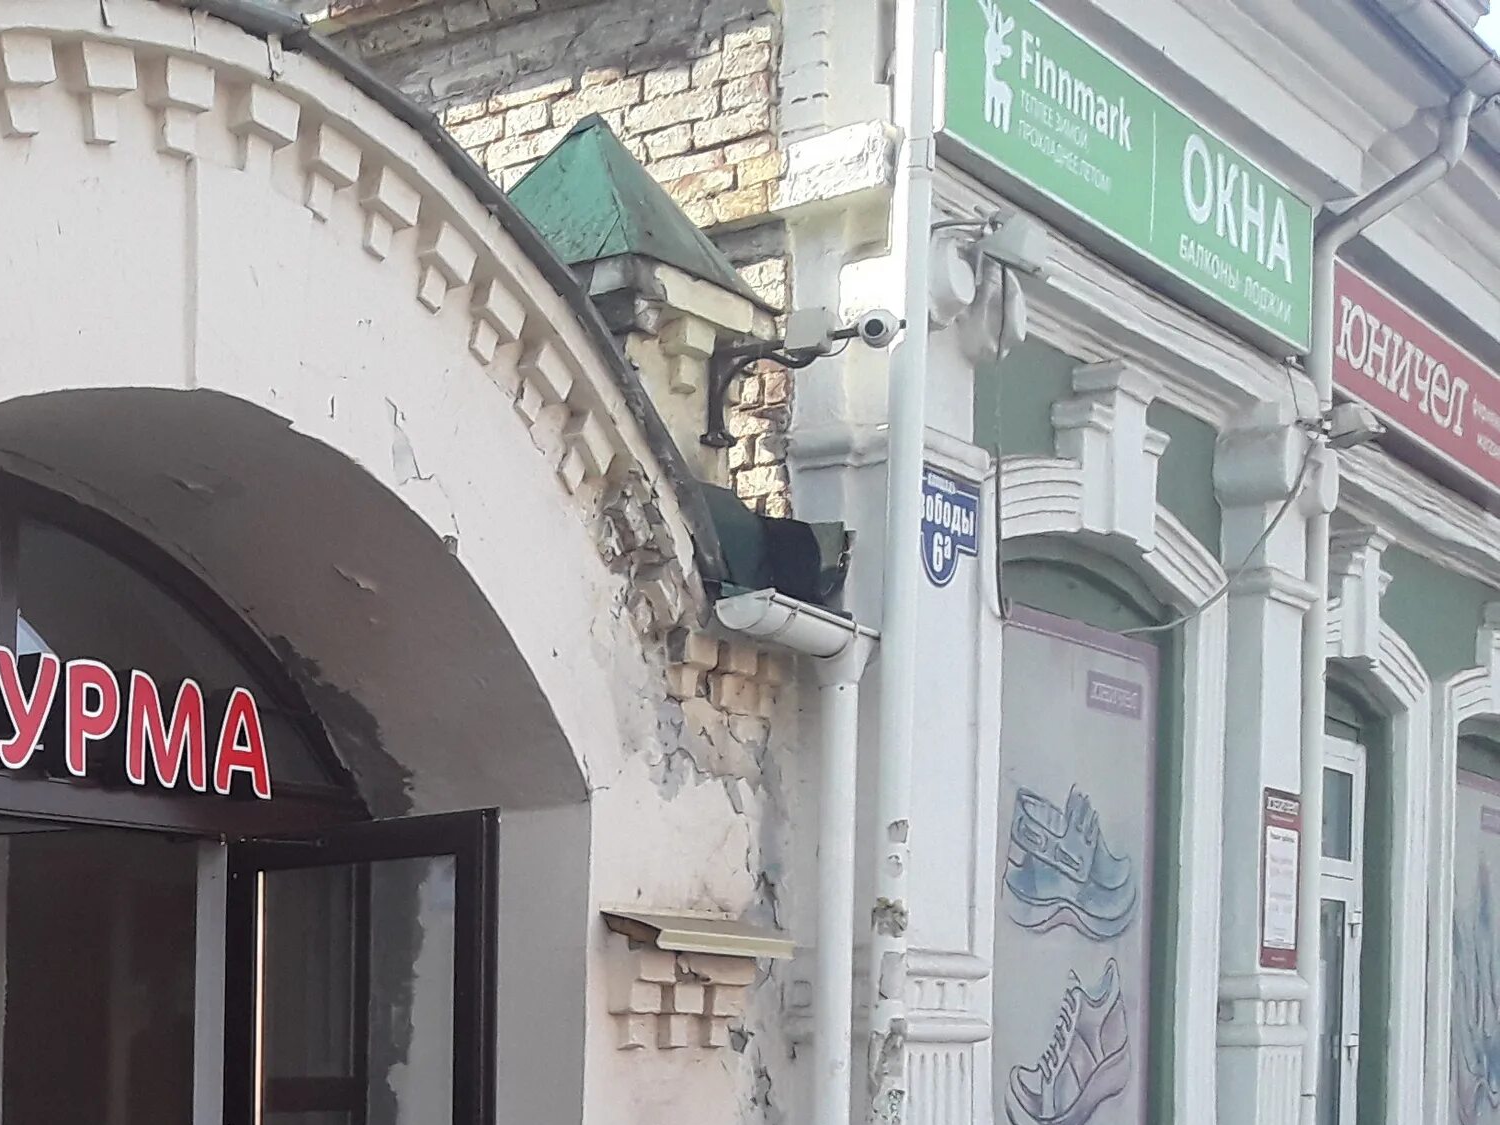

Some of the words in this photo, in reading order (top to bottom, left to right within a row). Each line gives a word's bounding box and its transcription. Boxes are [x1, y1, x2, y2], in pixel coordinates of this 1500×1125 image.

[1020, 29, 1132, 152] Finnmark
[1179, 233, 1240, 291] БАЛКОНЫ
[1182, 133, 1293, 285] ОКНА
